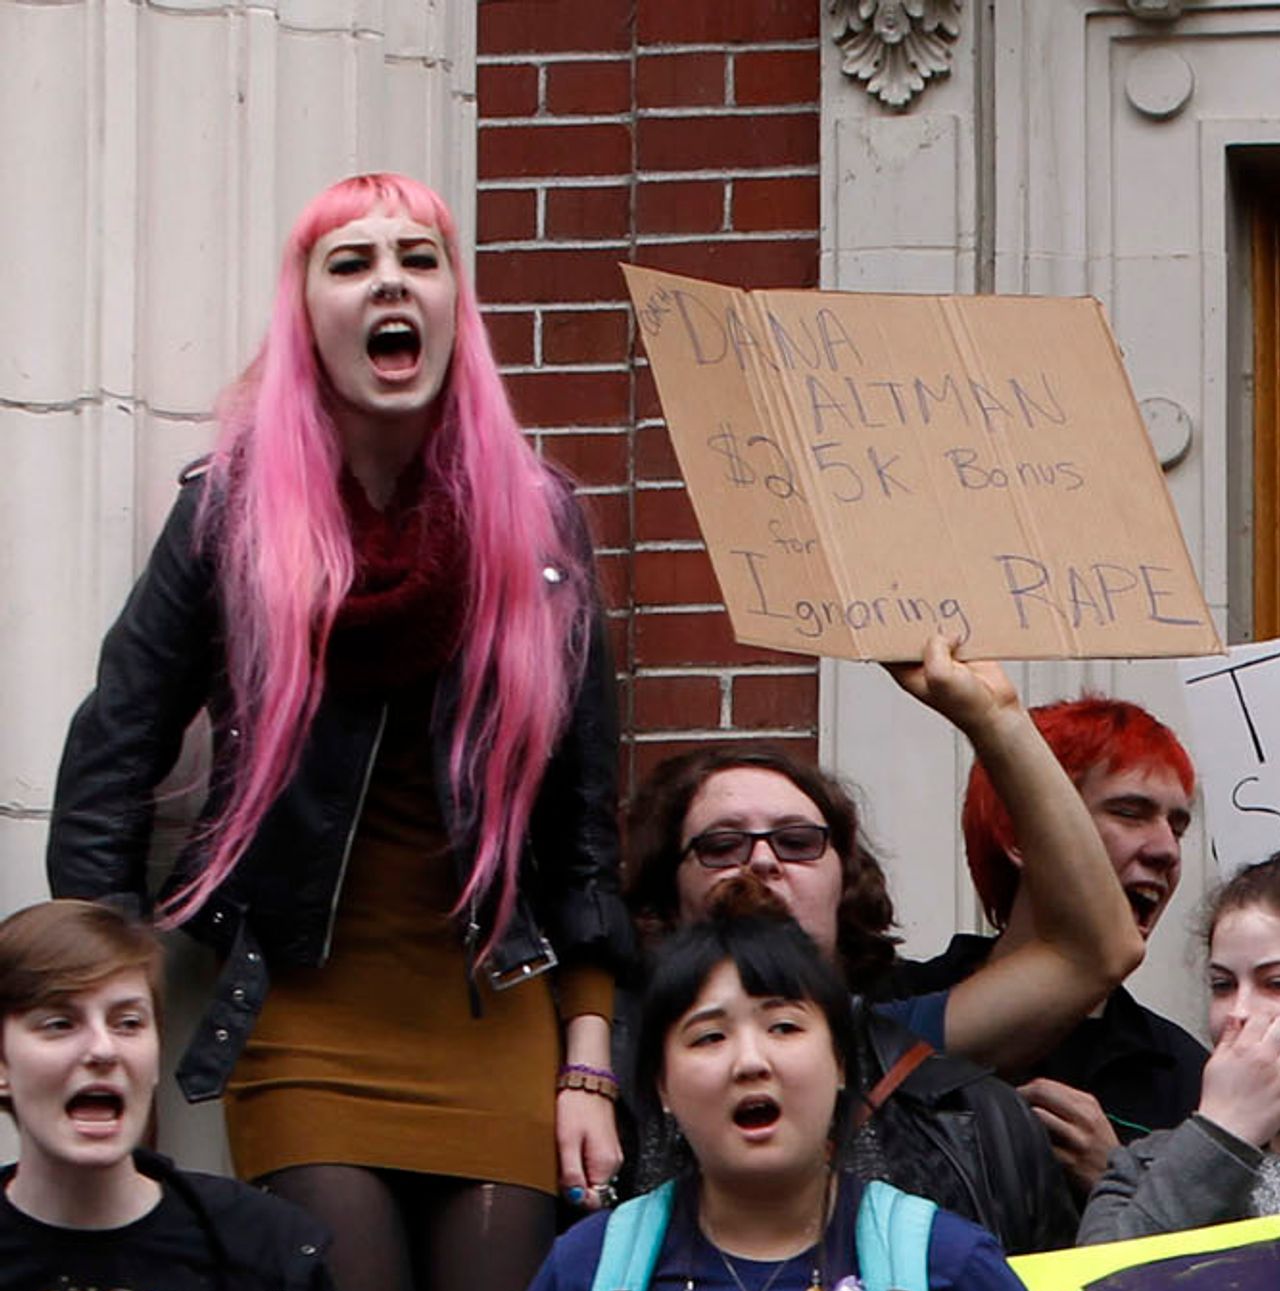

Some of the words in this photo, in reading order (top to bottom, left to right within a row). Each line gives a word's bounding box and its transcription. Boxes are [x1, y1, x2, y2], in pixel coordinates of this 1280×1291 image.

[669, 289, 863, 373] DANA
[805, 373, 1069, 434] ALTMAN
[945, 446, 1085, 491] Bonus
[768, 519, 815, 555] for
[730, 549, 971, 641] Ignoring
[994, 554, 1202, 630] RAPE
